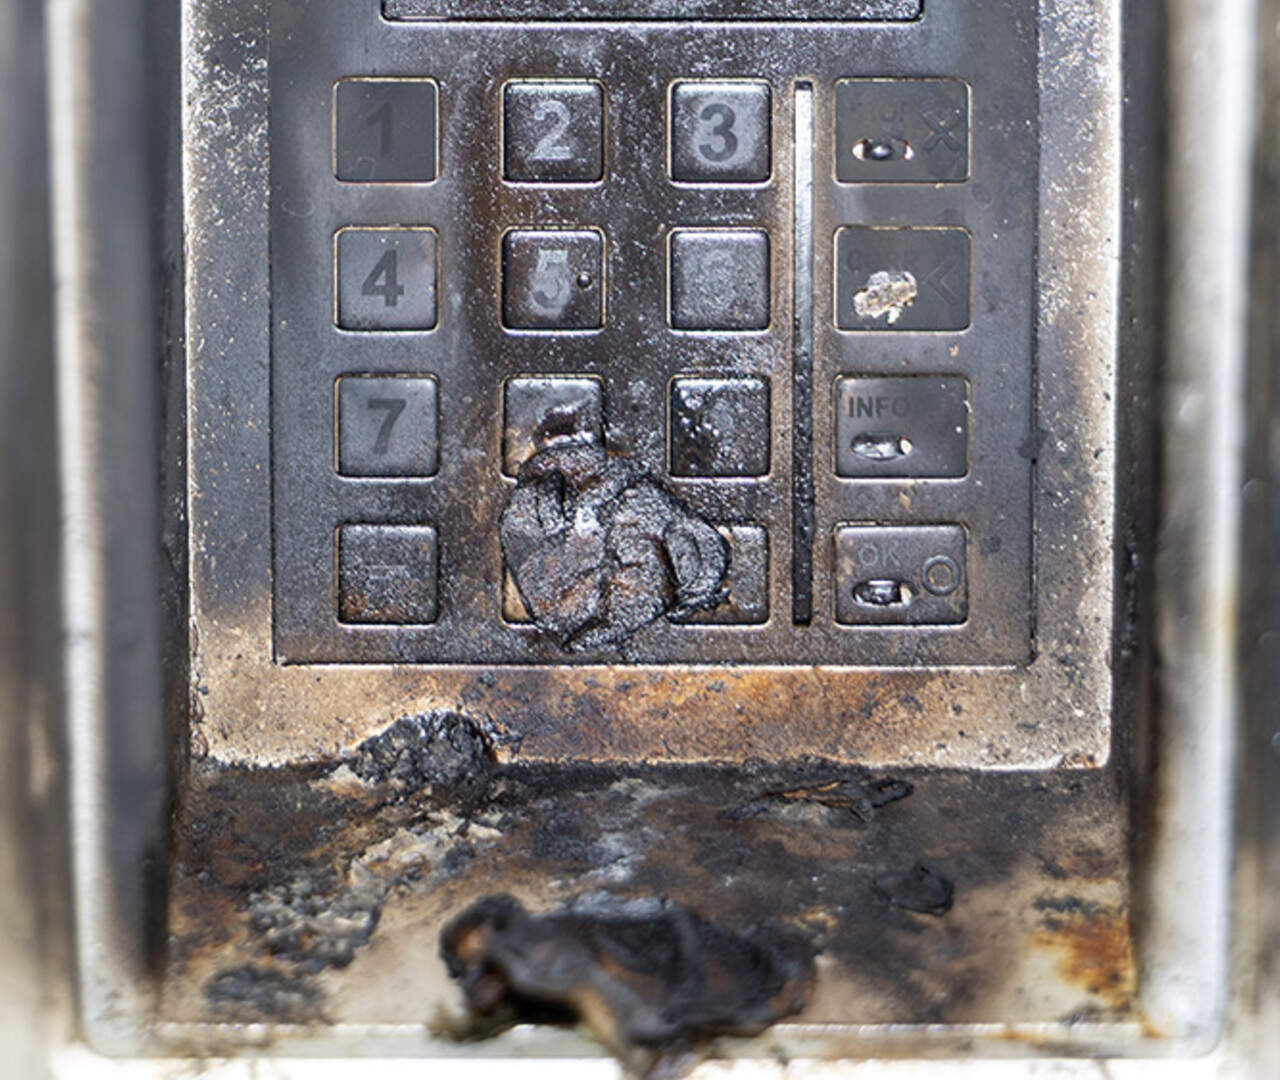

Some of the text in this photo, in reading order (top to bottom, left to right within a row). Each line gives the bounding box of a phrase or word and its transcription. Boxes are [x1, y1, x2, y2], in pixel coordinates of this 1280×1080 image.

[366, 102, 393, 159] 1
[532, 99, 573, 161] 2
[699, 103, 737, 162] 3
[361, 250, 405, 307] 4
[532, 249, 570, 309] 5
[367, 399, 407, 454] 7
[849, 396, 908, 418] INFO
[859, 544, 902, 567] OK
